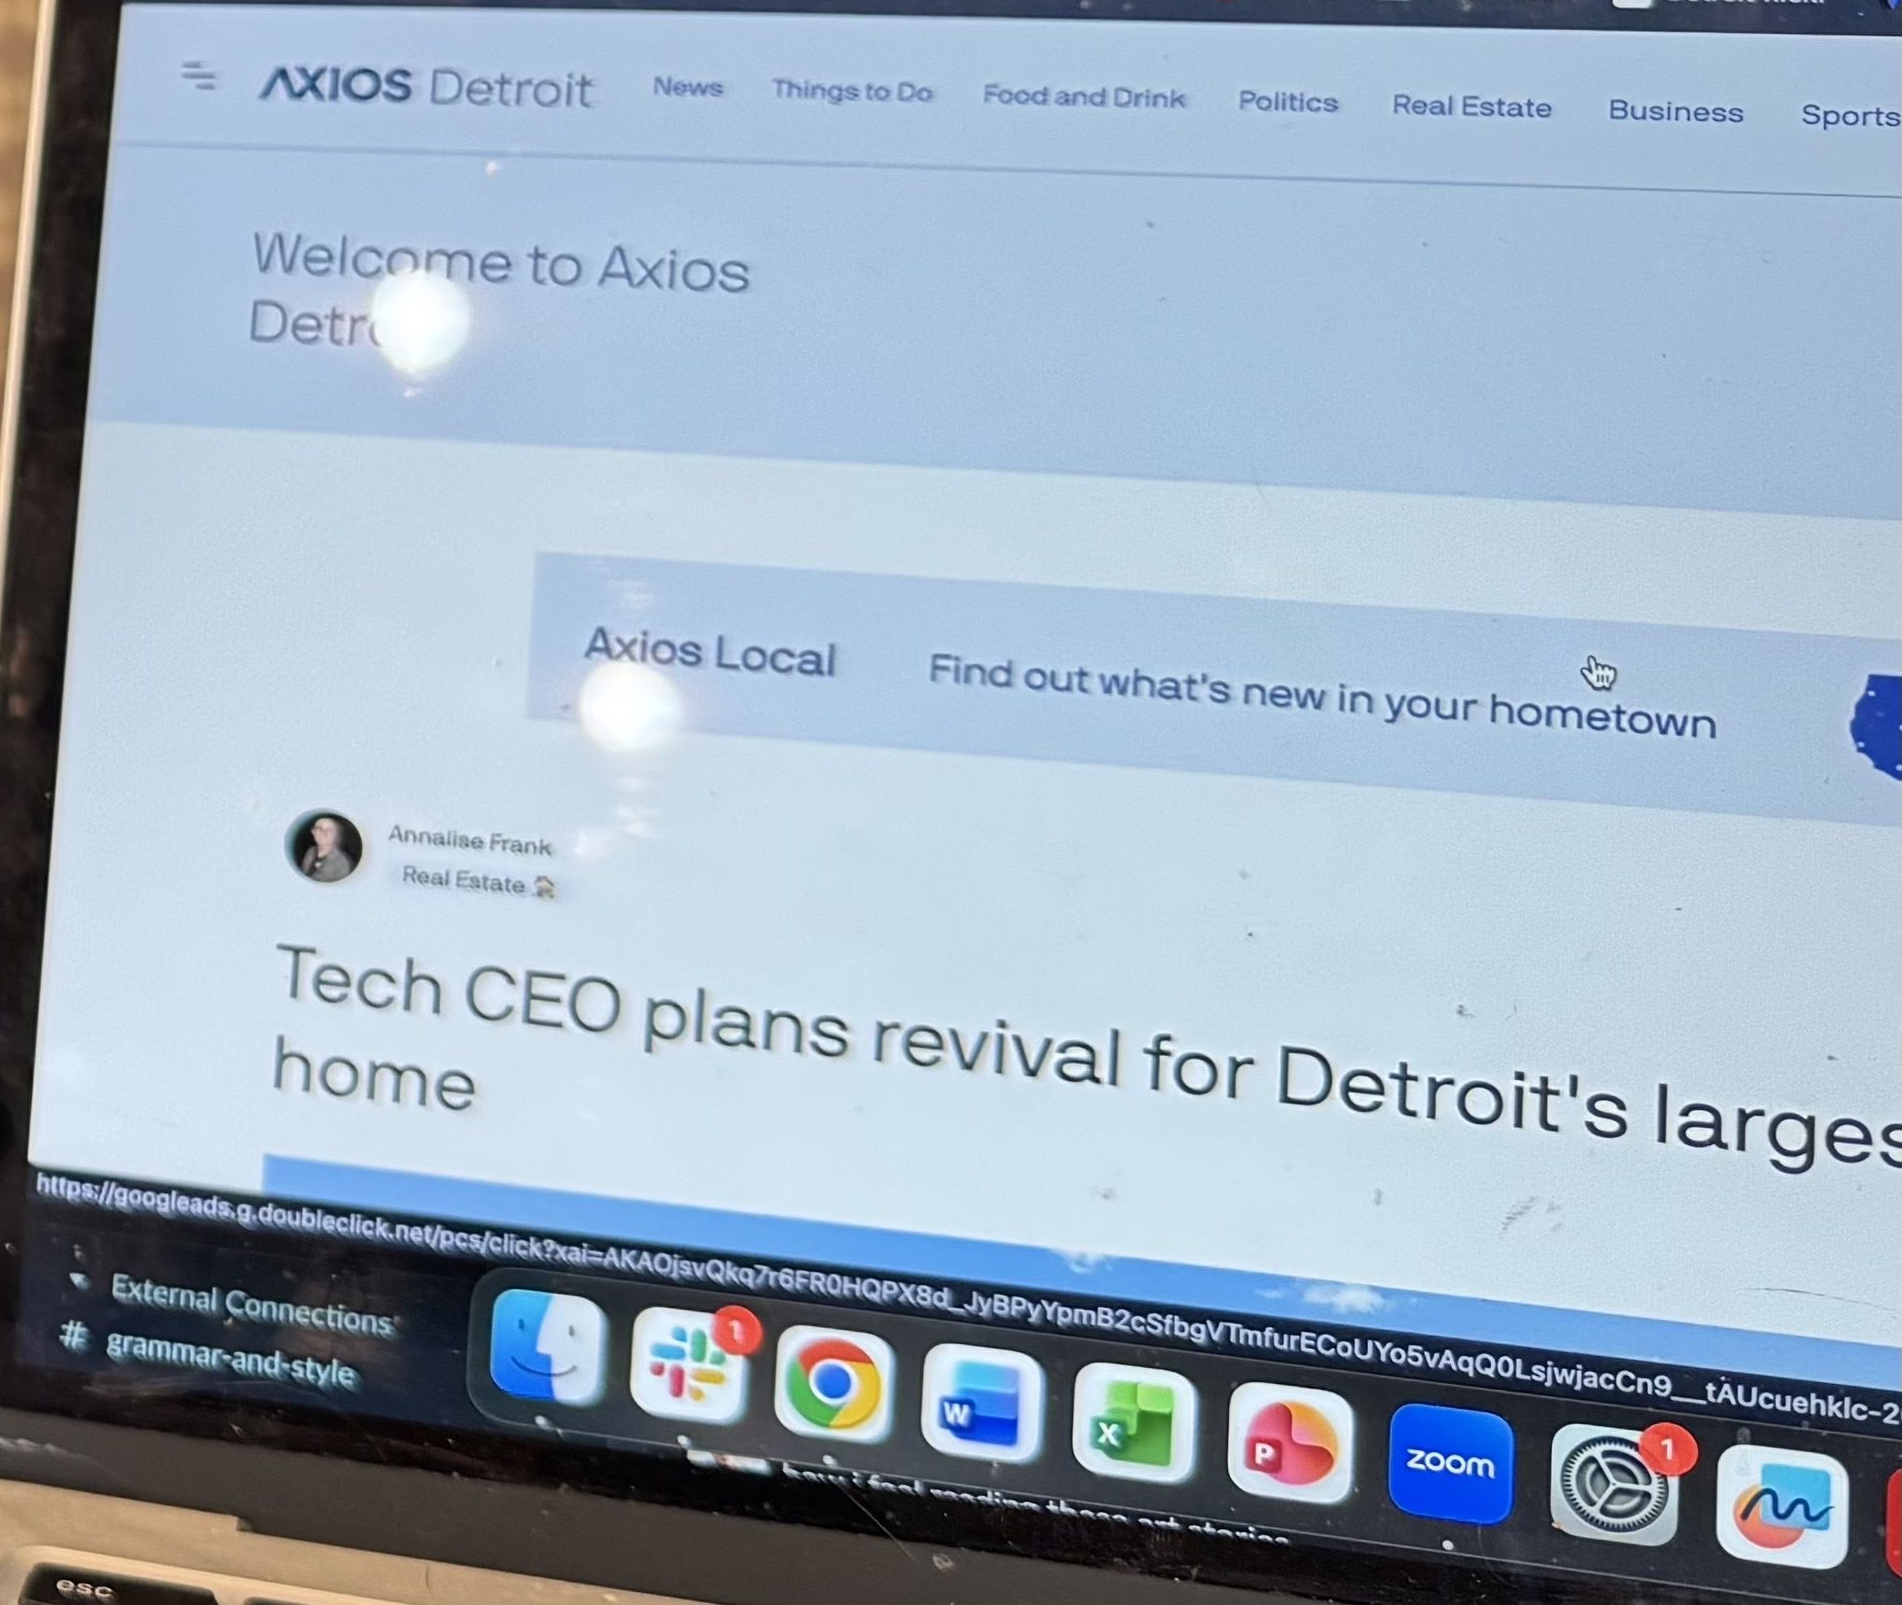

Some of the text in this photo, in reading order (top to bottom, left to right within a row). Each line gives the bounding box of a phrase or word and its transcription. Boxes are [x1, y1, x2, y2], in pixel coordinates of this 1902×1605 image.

[259, 66, 594, 109] AXIOS Detroit
[653, 75, 725, 97] News
[772, 77, 934, 106] Things to Do
[983, 83, 1186, 109] Food and Drink
[1239, 90, 1339, 113] Politics
[1393, 94, 1553, 119] Real Estate
[1609, 99, 1744, 123] Business
[1801, 103, 1902, 131] Sports
[253, 231, 753, 293] Welcome to Axios
[250, 299, 381, 347] Detr
[584, 626, 836, 678] Axios Local
[930, 653, 1718, 740] Find out what's new in your hometown
[388, 825, 552, 857] Annalise Frank
[403, 865, 526, 894] Real Estate
[272, 1034, 476, 1112] home
[276, 943, 1902, 1175] Tech CEO plans revival for Detroit's larges
[112, 1273, 397, 1338] External Connections
[107, 1330, 361, 1391] grammar-and-style
[943, 1400, 970, 1426] W
[1098, 1422, 1121, 1448] X
[1659, 1437, 1675, 1461] 1
[1254, 1442, 1275, 1465] P
[1406, 1447, 1496, 1480] zoom
[56, 1579, 116, 1601] esc
